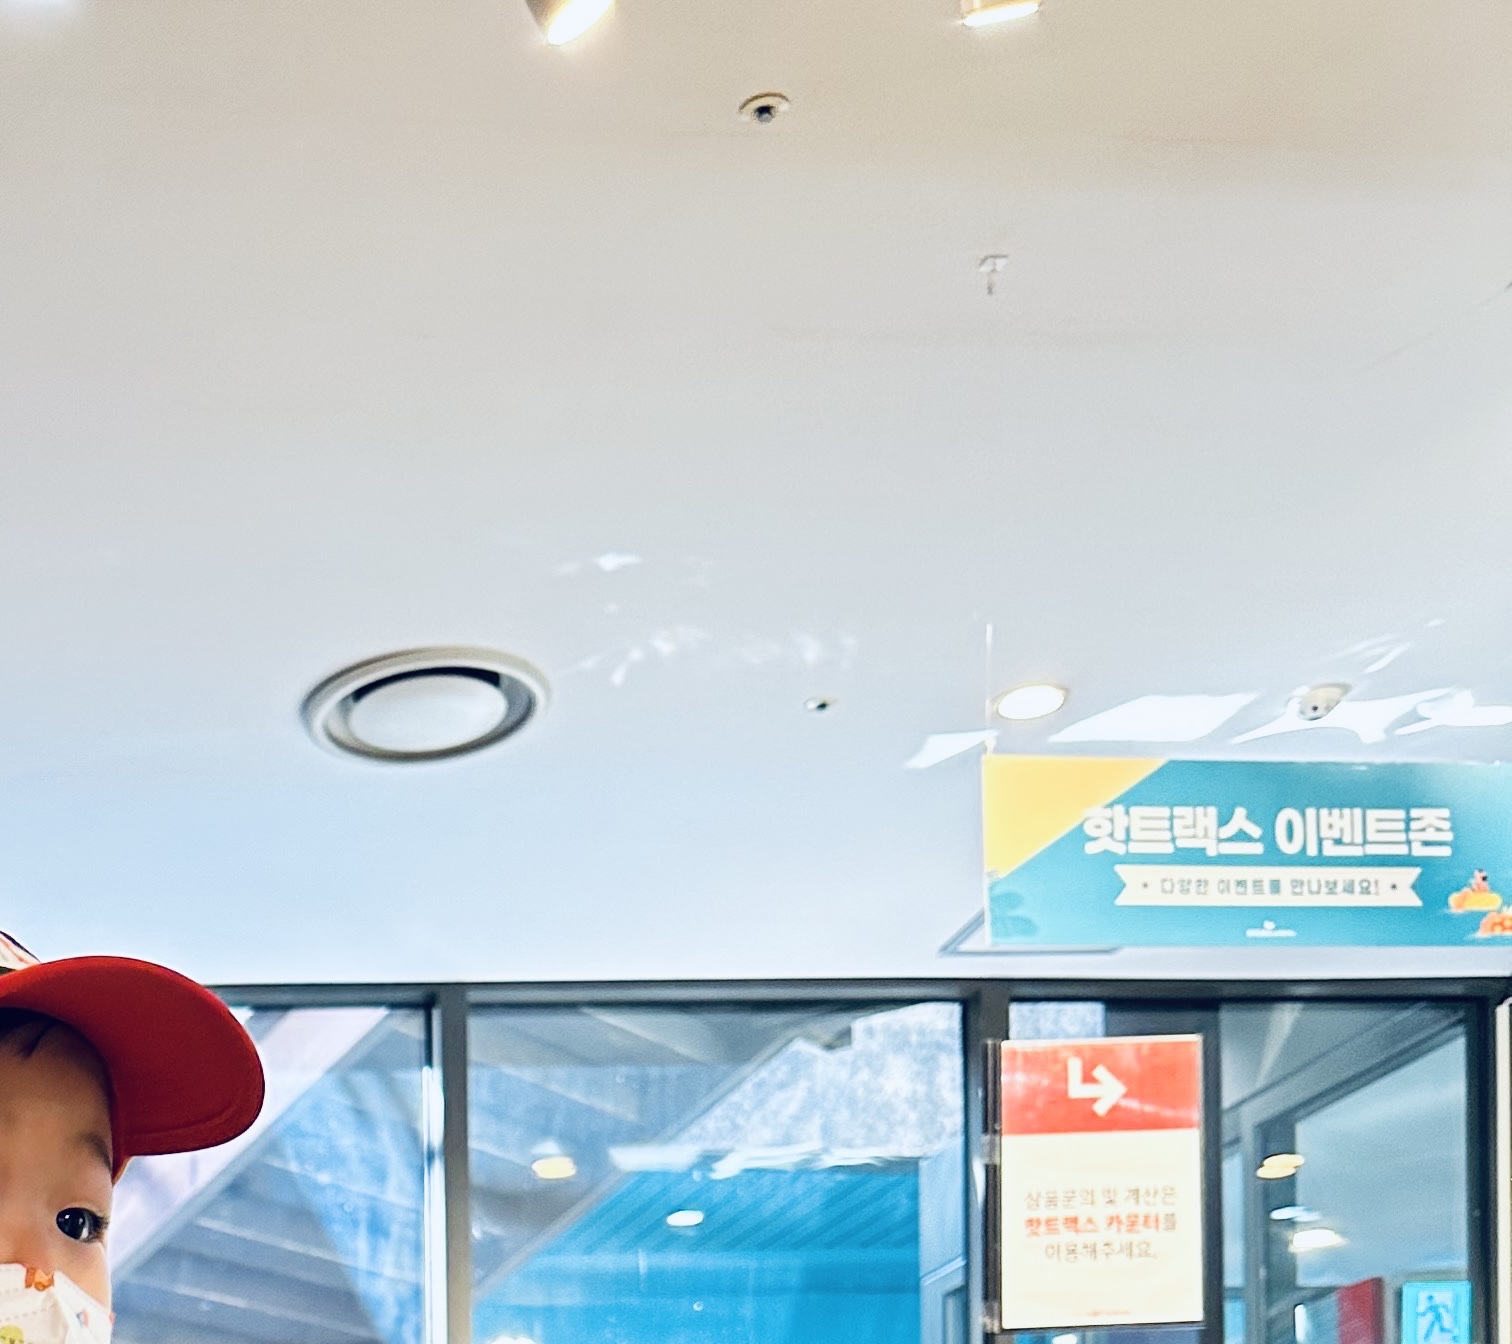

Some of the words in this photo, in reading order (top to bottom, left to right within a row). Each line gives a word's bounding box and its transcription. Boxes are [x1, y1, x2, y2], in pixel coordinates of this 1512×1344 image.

[1084, 806, 1264, 856] 핫트랙스
[1275, 806, 1453, 857] 이벤트존
[1160, 878, 1209, 896] 다양한
[1217, 878, 1281, 895] 이벤트를
[1290, 878, 1380, 896] 만나보세요!
[1025, 1214, 1099, 1237] 핫트랙스
[1106, 1212, 1177, 1235] 카운터를
